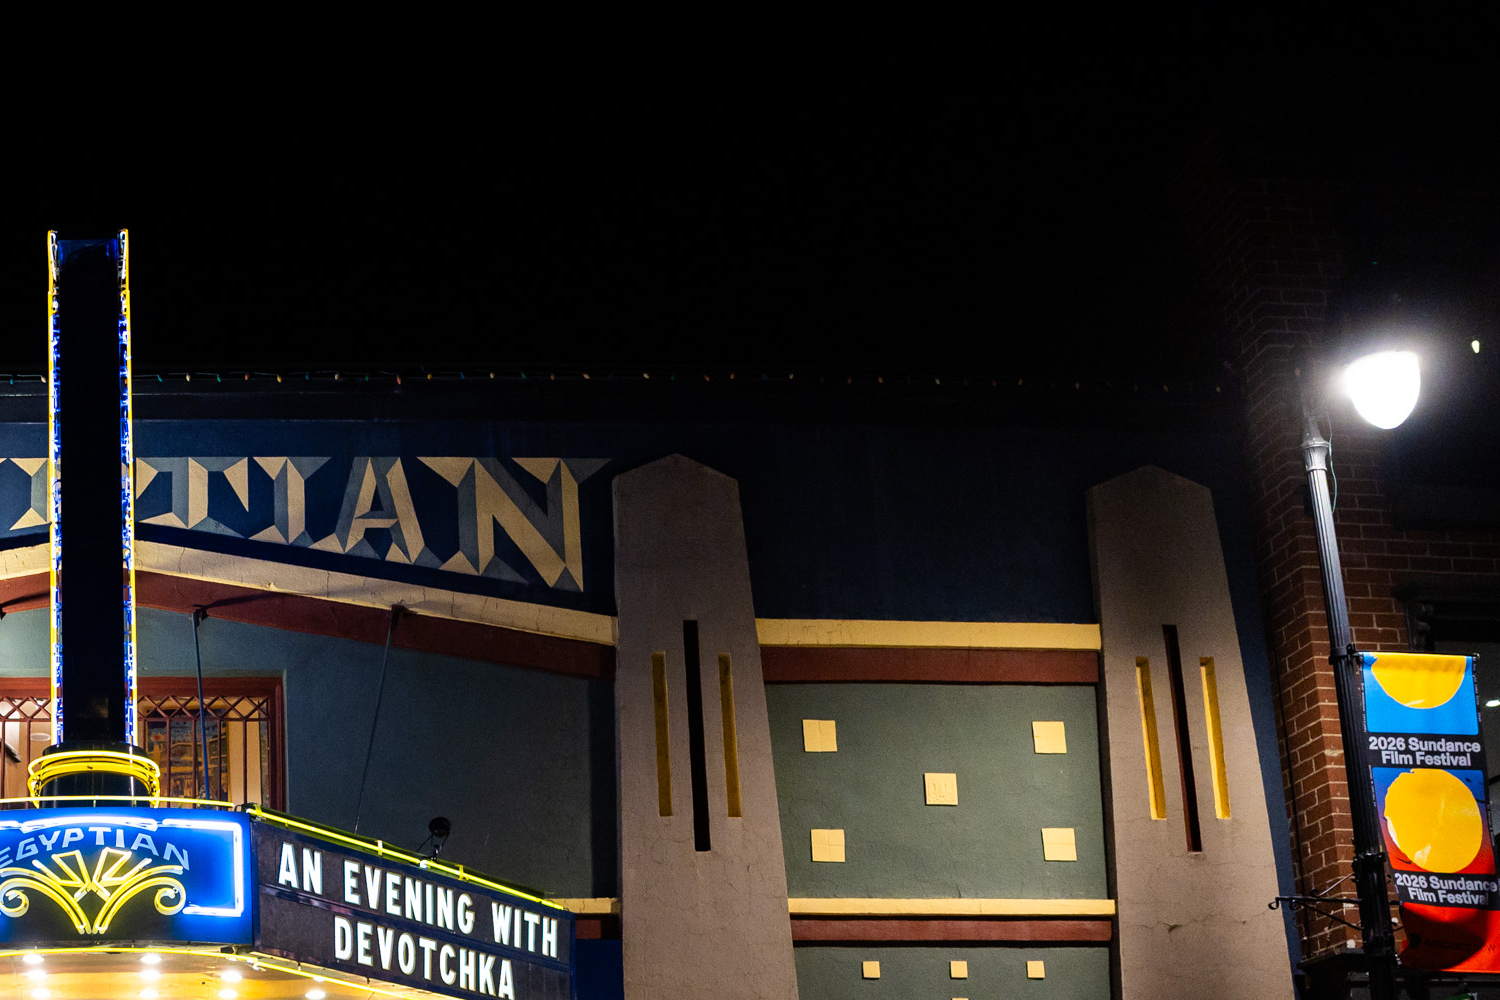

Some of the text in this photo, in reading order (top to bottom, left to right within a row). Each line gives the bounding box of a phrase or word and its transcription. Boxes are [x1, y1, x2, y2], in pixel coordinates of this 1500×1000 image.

[1368, 736, 1481, 753] 2026 Sundance
[1381, 751, 1472, 767] Film Festival
[1394, 873, 1498, 893] 2026 Sundance
[278, 842, 559, 959] AN EVENING WITH
[1407, 887, 1489, 906] Film Festival
[333, 915, 516, 1000] DEVOTCHKA
